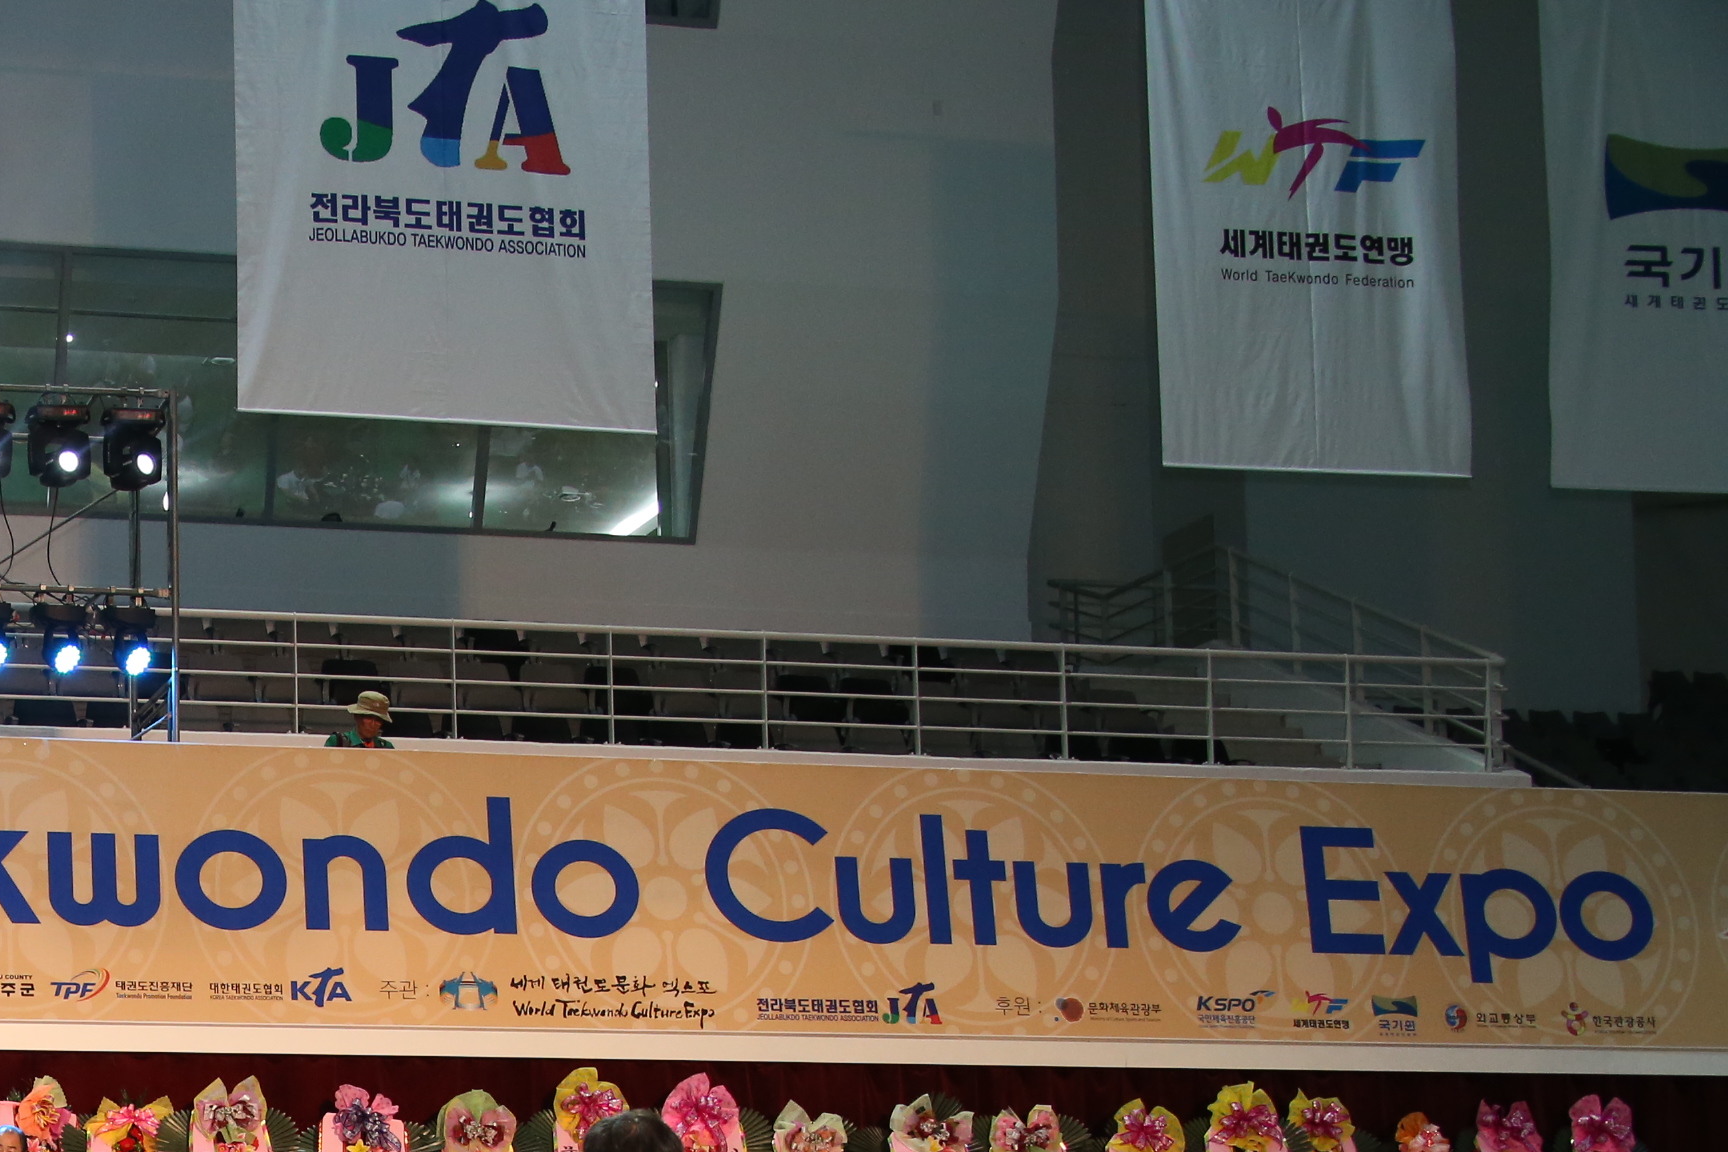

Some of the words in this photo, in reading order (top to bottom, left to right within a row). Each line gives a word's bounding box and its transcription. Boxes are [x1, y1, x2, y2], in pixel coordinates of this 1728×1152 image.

[310, 192, 586, 240] 전라북도태권도협회
[309, 227, 407, 246] JEOLLABUKDO
[412, 233, 494, 252] TAEKWONDO
[498, 238, 586, 258] ASSOCIATION
[1220, 229, 1414, 266] 세계태권도연맹
[1221, 268, 1258, 283] World
[1266, 270, 1339, 286] TaeKwondo
[1346, 272, 1414, 289] Federation
[706, 808, 1241, 953] Culture
[1300, 825, 1655, 984] Expo
[50, 981, 96, 1000] TPF
[115, 980, 193, 992] 태권도진흥재단
[209, 982, 284, 996] 대한태권도협회
[290, 967, 353, 1008] KTA
[379, 979, 418, 1000] 주관
[756, 998, 878, 1014] 전라북도태권도협회
[1088, 1002, 1162, 1016] 문화체육관광부
[1196, 996, 1256, 1012] KSPO
[512, 1000, 555, 1019] World
[631, 1001, 682, 1020] Culture
[684, 1002, 715, 1029] Expo
[801, 1014, 838, 1022] TAEKWONDO
[1592, 1015, 1657, 1028] 한국관광공사
[1293, 1019, 1349, 1030] 세계태권도연맹
[1378, 1019, 1417, 1032] 국기원
